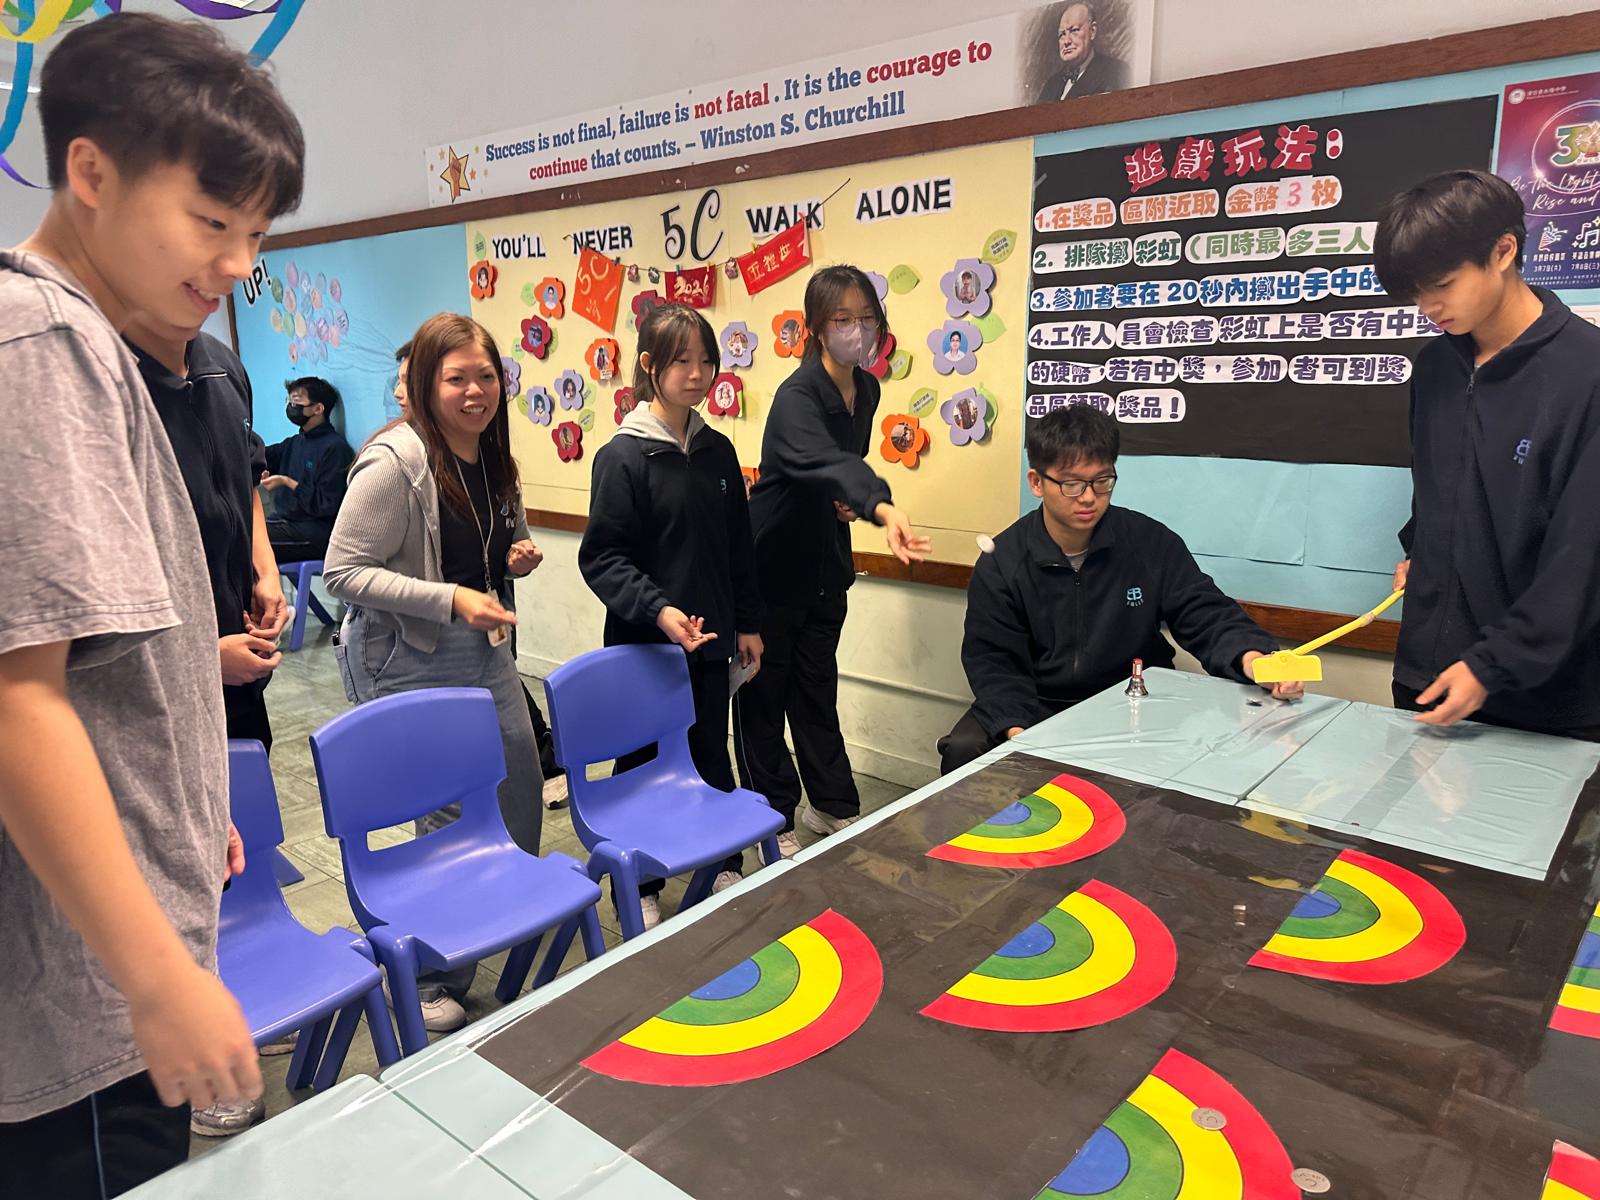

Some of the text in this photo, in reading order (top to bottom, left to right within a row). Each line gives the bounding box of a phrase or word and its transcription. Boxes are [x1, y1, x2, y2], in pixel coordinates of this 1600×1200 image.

[486, 139, 536, 162] Success
[538, 133, 549, 151] is
[552, 128, 575, 148] not
[577, 117, 616, 143] final,
[619, 110, 671, 134] failure
[674, 102, 690, 123] is
[694, 96, 722, 119] not
[726, 82, 770, 113] fatal
[783, 79, 800, 101] It
[803, 74, 822, 97] is
[827, 67, 861, 92] the
[866, 47, 961, 84] courage
[967, 40, 993, 63] to
[529, 156, 588, 180] continue
[591, 149, 621, 170] that
[624, 139, 681, 164] counts.
[700, 121, 776, 150] Winston
[780, 113, 800, 136] S.
[804, 90, 906, 131] Churchill
[1124, 124, 1344, 192] 遊戲玩法:
[492, 178, 951, 262] YOU'LL NEVER 5C WALK ALONE
[1570, 190, 1600, 206] and
[242, 258, 271, 304] UP!
[577, 256, 609, 295] 5C
